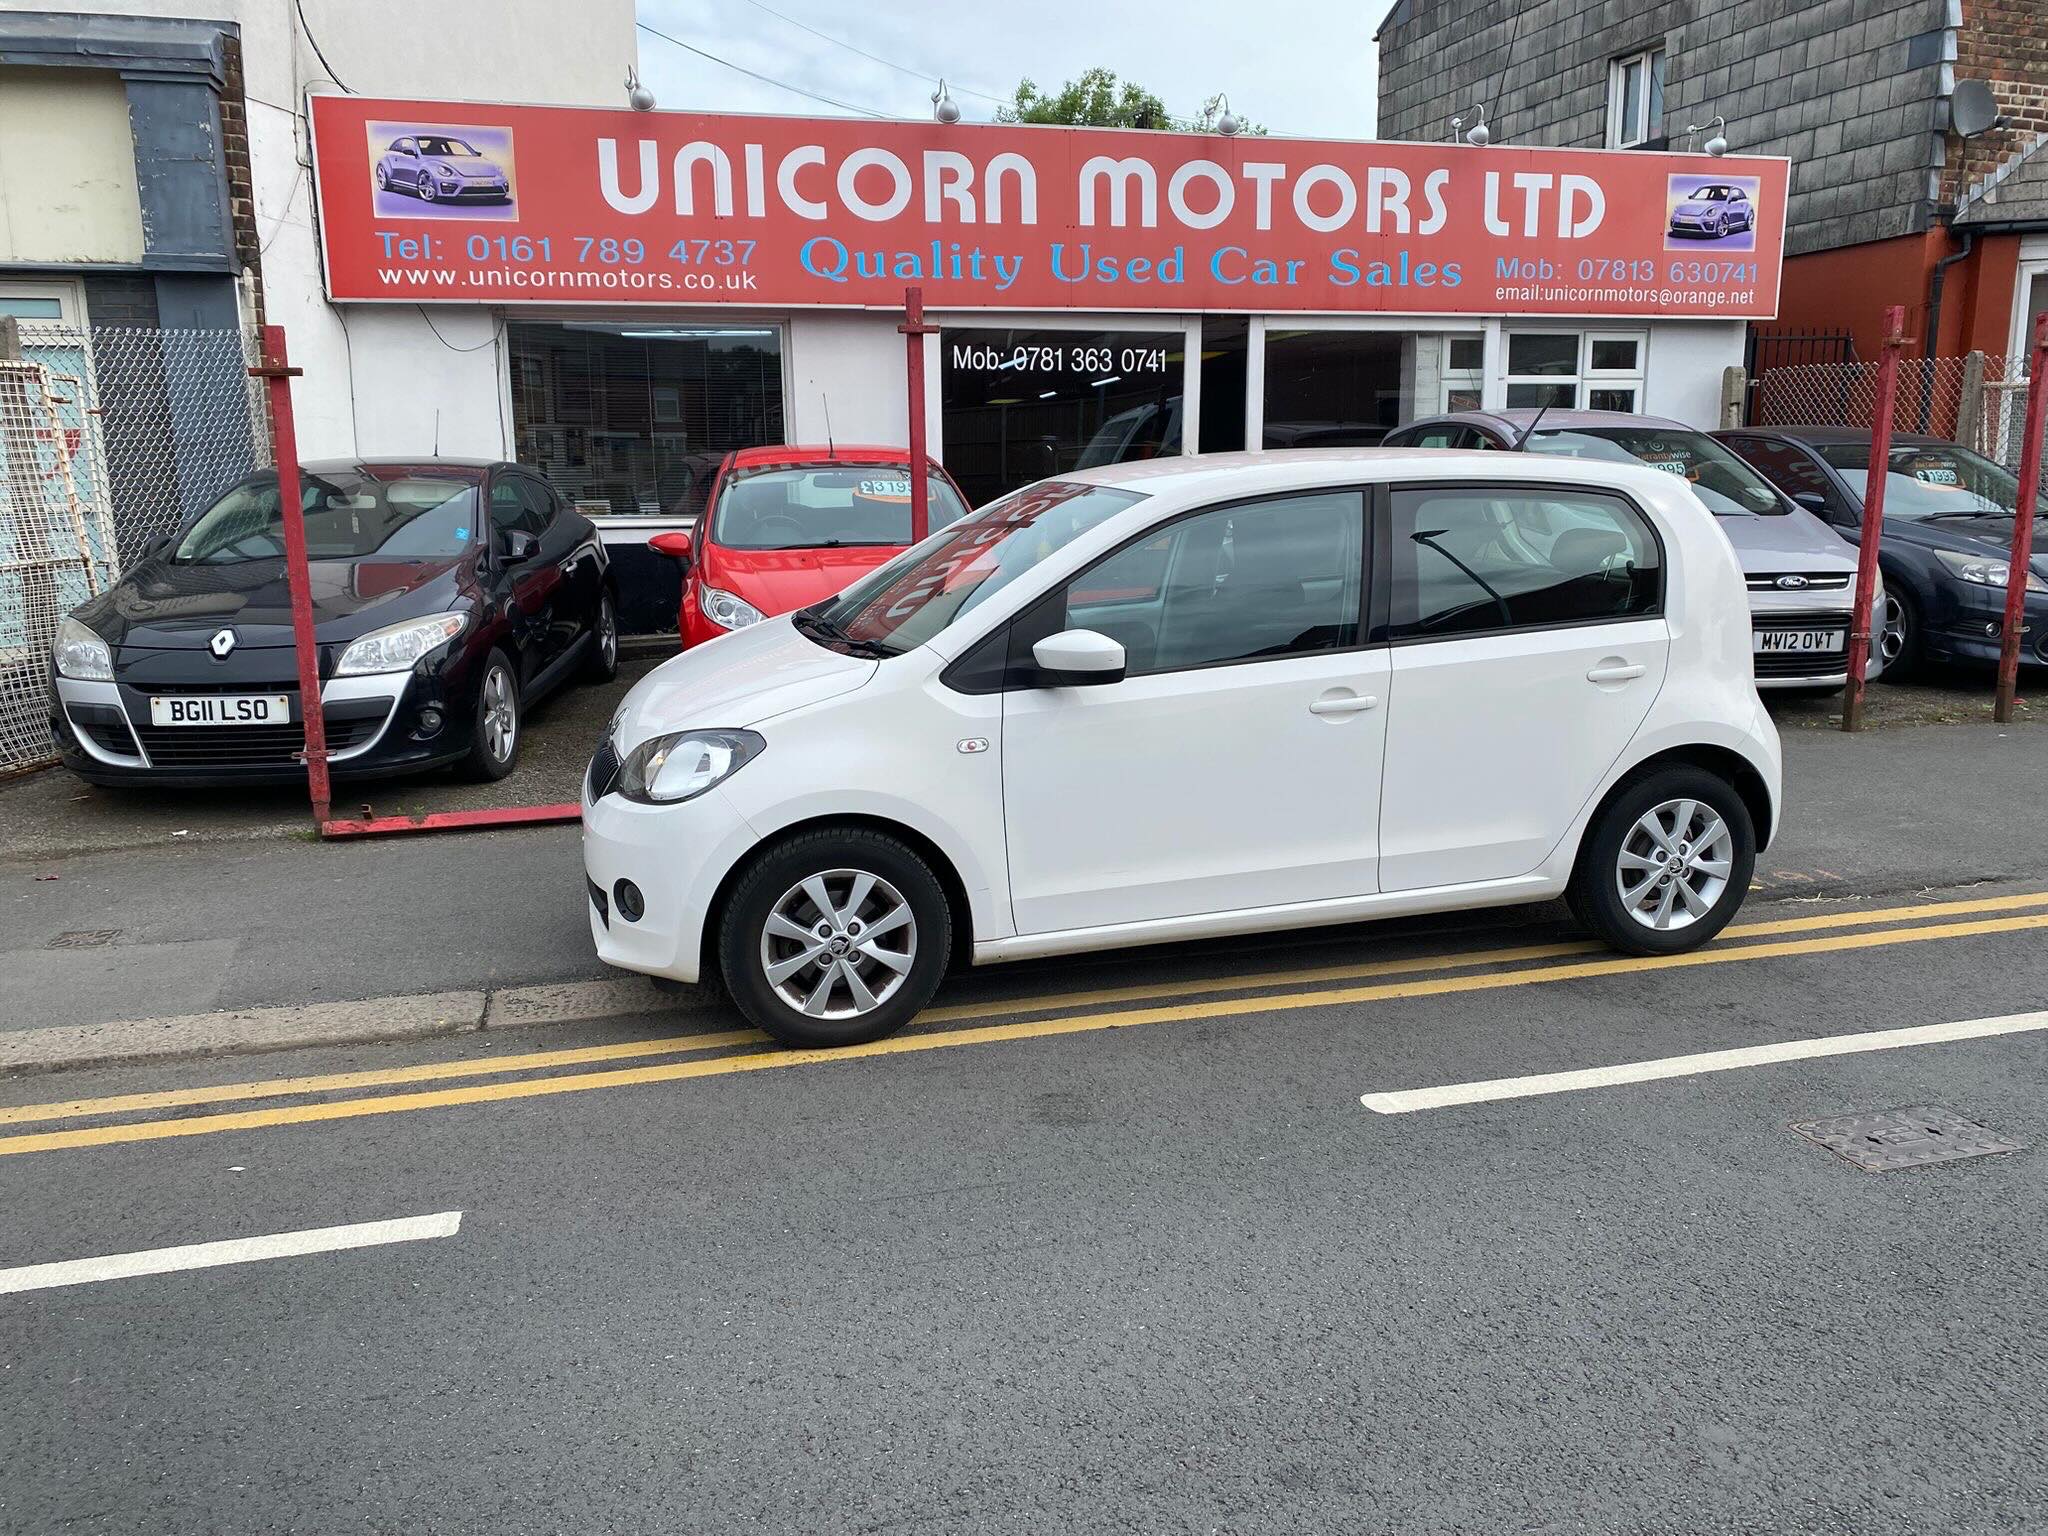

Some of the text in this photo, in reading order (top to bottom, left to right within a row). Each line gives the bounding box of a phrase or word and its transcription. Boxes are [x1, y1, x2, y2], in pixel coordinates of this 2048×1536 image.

[598, 138, 1606, 239] UNICORN MOTORS LTD
[375, 231, 757, 265] Tel: 0161 789 4737
[800, 236, 1463, 290] Quality Used Car Sales
[1496, 257, 1759, 284] Mob: 07813 630741
[378, 266, 757, 292] www.unicornmotors.co.uk
[1496, 284, 1755, 307] email:unicornmotors@orange.net
[953, 345, 1166, 373] Mob: 0781 363 0741
[860, 480, 912, 494] £319
[1761, 633, 1834, 649] MV12 OVT
[170, 699, 269, 721] BG11 LSO
